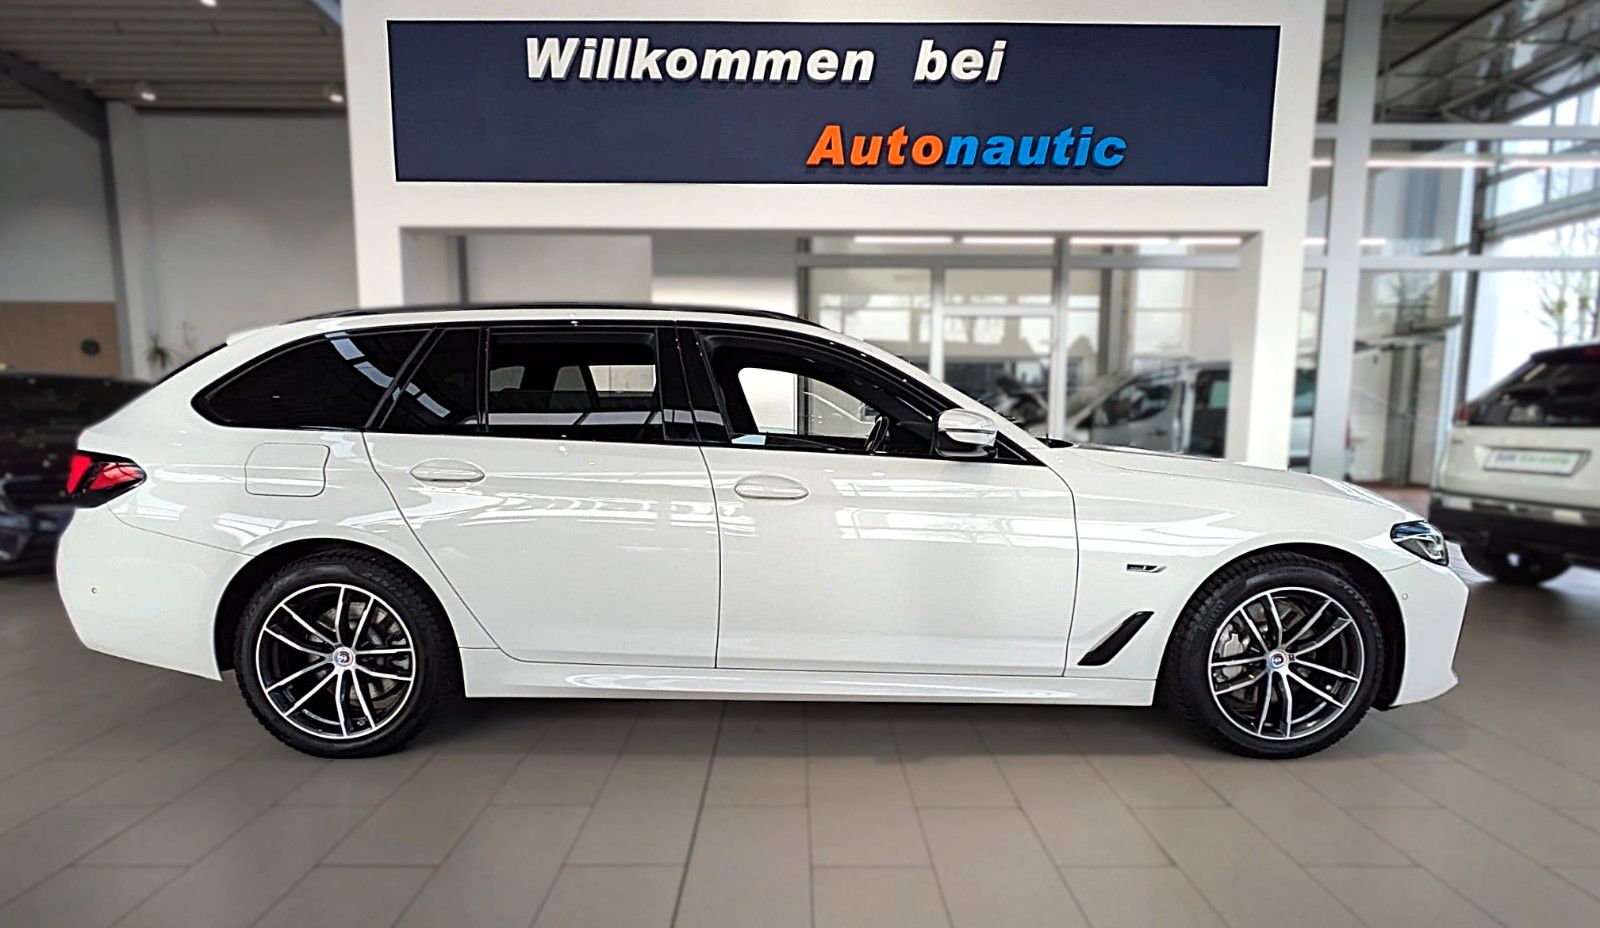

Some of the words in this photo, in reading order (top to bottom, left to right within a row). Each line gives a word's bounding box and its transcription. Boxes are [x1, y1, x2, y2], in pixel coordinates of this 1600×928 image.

[526, 37, 875, 82] Willkommen
[913, 39, 1007, 83] bei
[806, 124, 1127, 168] Autonautic
